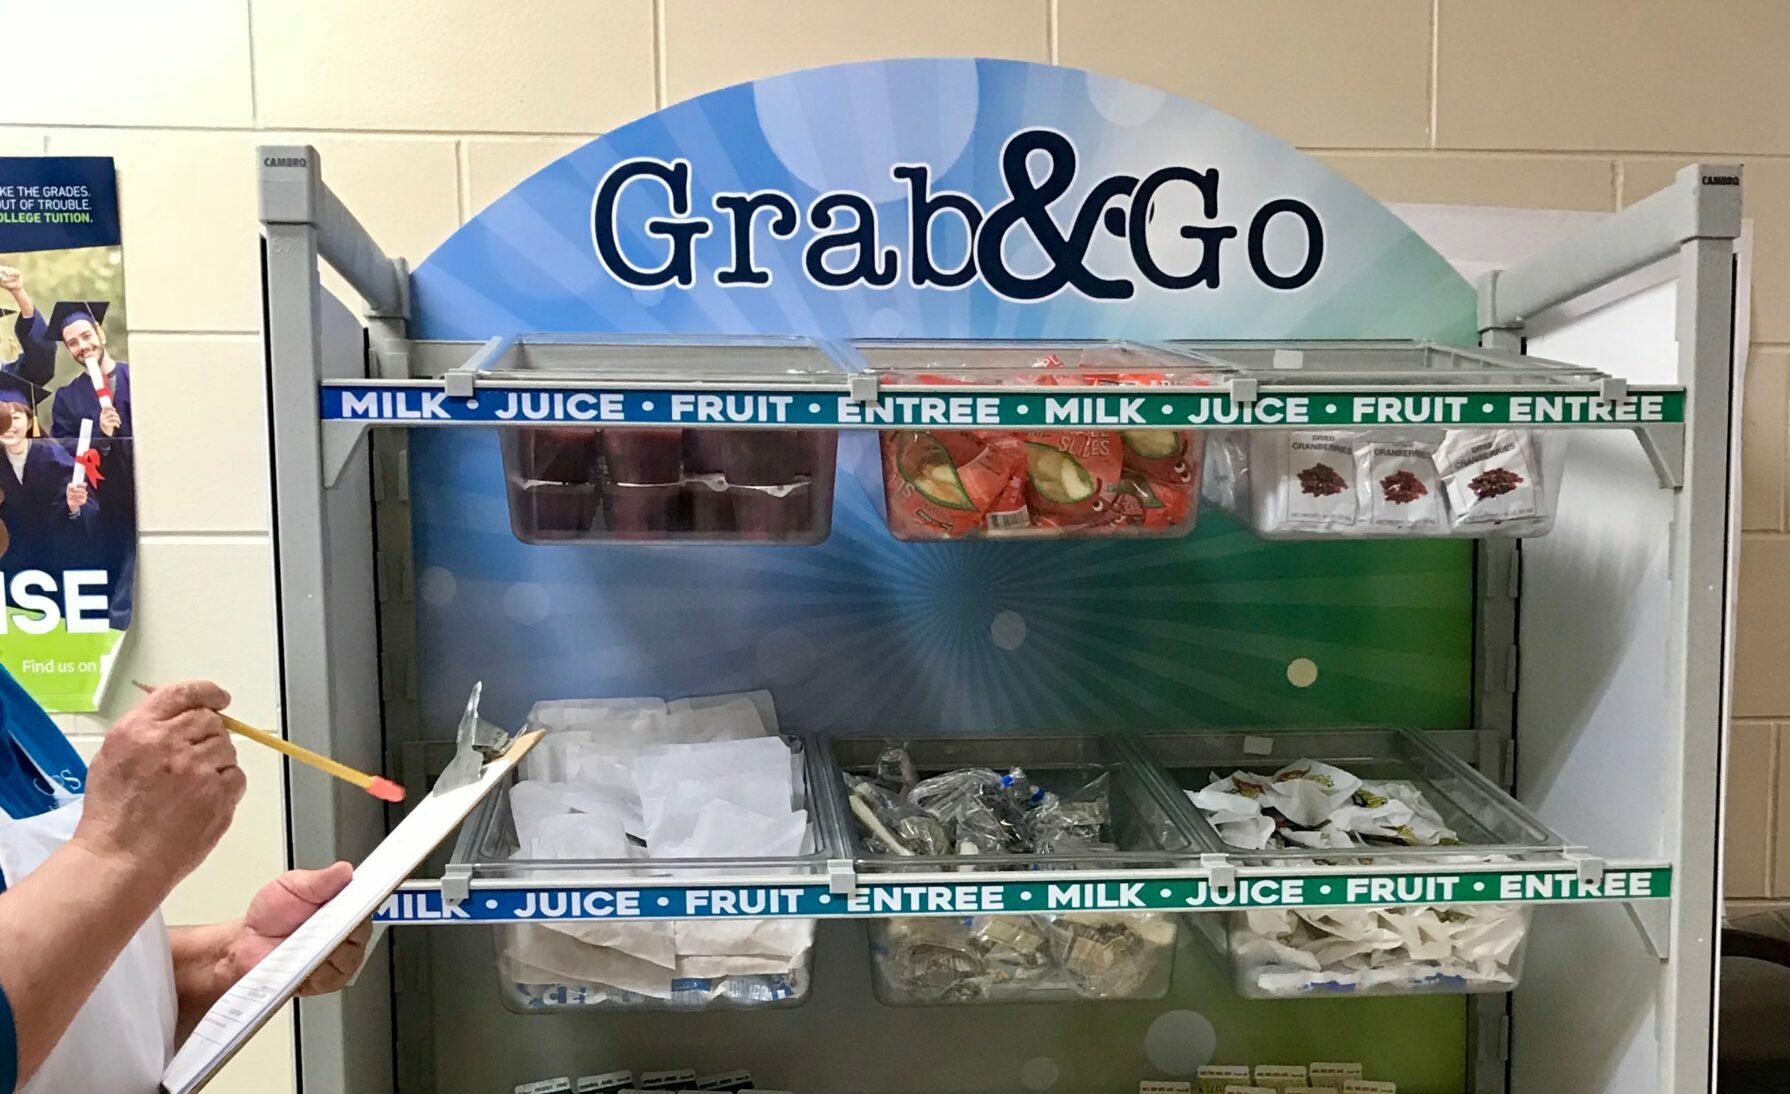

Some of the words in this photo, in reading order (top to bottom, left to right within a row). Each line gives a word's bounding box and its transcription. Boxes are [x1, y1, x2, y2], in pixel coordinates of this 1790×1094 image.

[263, 157, 307, 168] CAMBRO
[17, 186, 40, 197] THE
[43, 186, 91, 197] GRADES.
[20, 199, 34, 210] OF
[38, 199, 92, 210] TROUBLE.
[44, 212, 93, 223] TUITION.
[342, 392, 451, 419] MILK
[495, 393, 624, 419] JUICE
[672, 395, 793, 422] FRUIT
[838, 397, 1000, 424] ENTREE
[1045, 397, 1147, 424] MILK
[1187, 397, 1309, 424] JUICE
[1353, 397, 1468, 423] FRUIT
[1510, 395, 1664, 423] ENTREE
[22, 659, 54, 673] Find
[58, 662, 75, 673] us
[78, 661, 96, 672] on
[372, 892, 470, 919] MILK
[513, 891, 640, 917] JUICE
[686, 888, 804, 915] FRUIT
[848, 884, 1004, 912] ENTREE
[1047, 883, 1146, 909] MILK
[1186, 880, 1304, 906] JUICE
[1346, 876, 1459, 902] FRUIT
[1500, 873, 1651, 899] ENTREE
